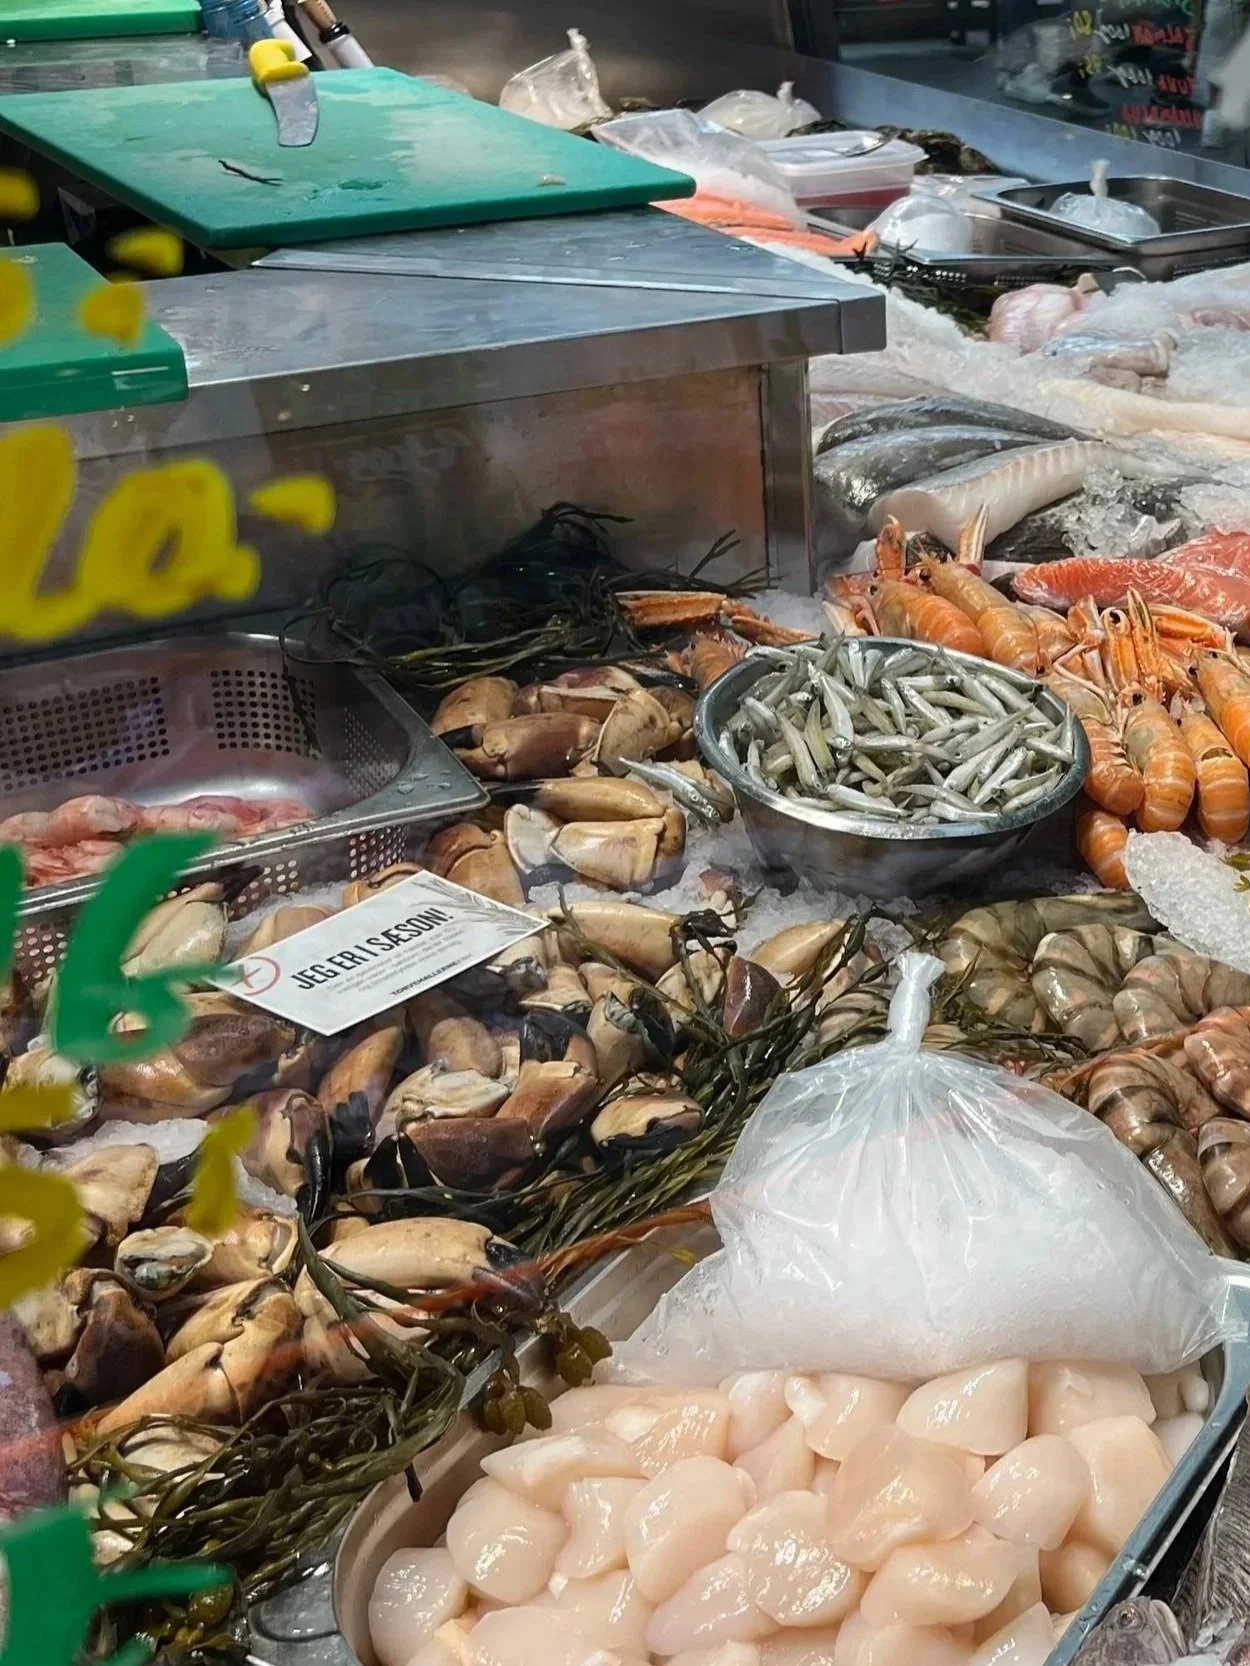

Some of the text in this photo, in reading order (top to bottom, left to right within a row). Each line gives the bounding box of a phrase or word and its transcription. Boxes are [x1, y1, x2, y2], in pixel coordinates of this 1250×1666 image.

[290, 907, 454, 990] JEG ER I SÆSON!
